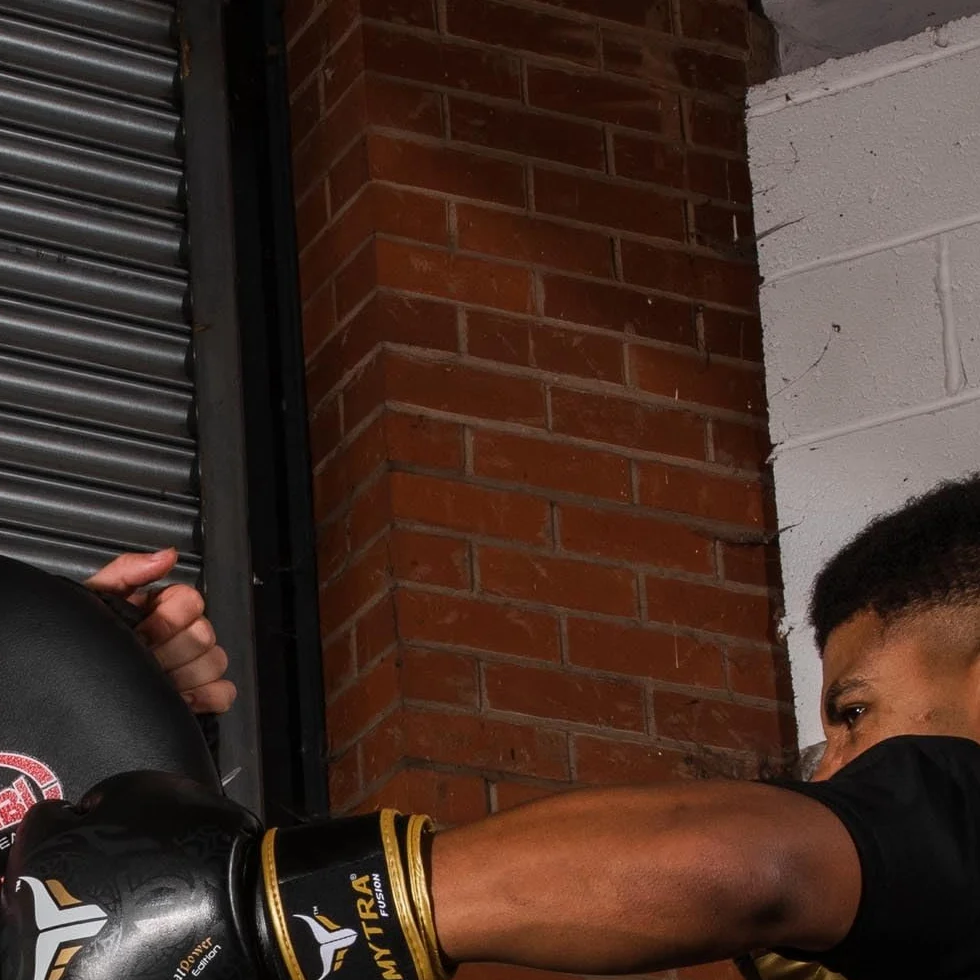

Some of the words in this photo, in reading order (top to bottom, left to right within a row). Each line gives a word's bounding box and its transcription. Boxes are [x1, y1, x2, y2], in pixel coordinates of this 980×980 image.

[372, 873, 389, 917] FUSION
[351, 874, 403, 980] MYTRA
[191, 944, 222, 977] Edition
